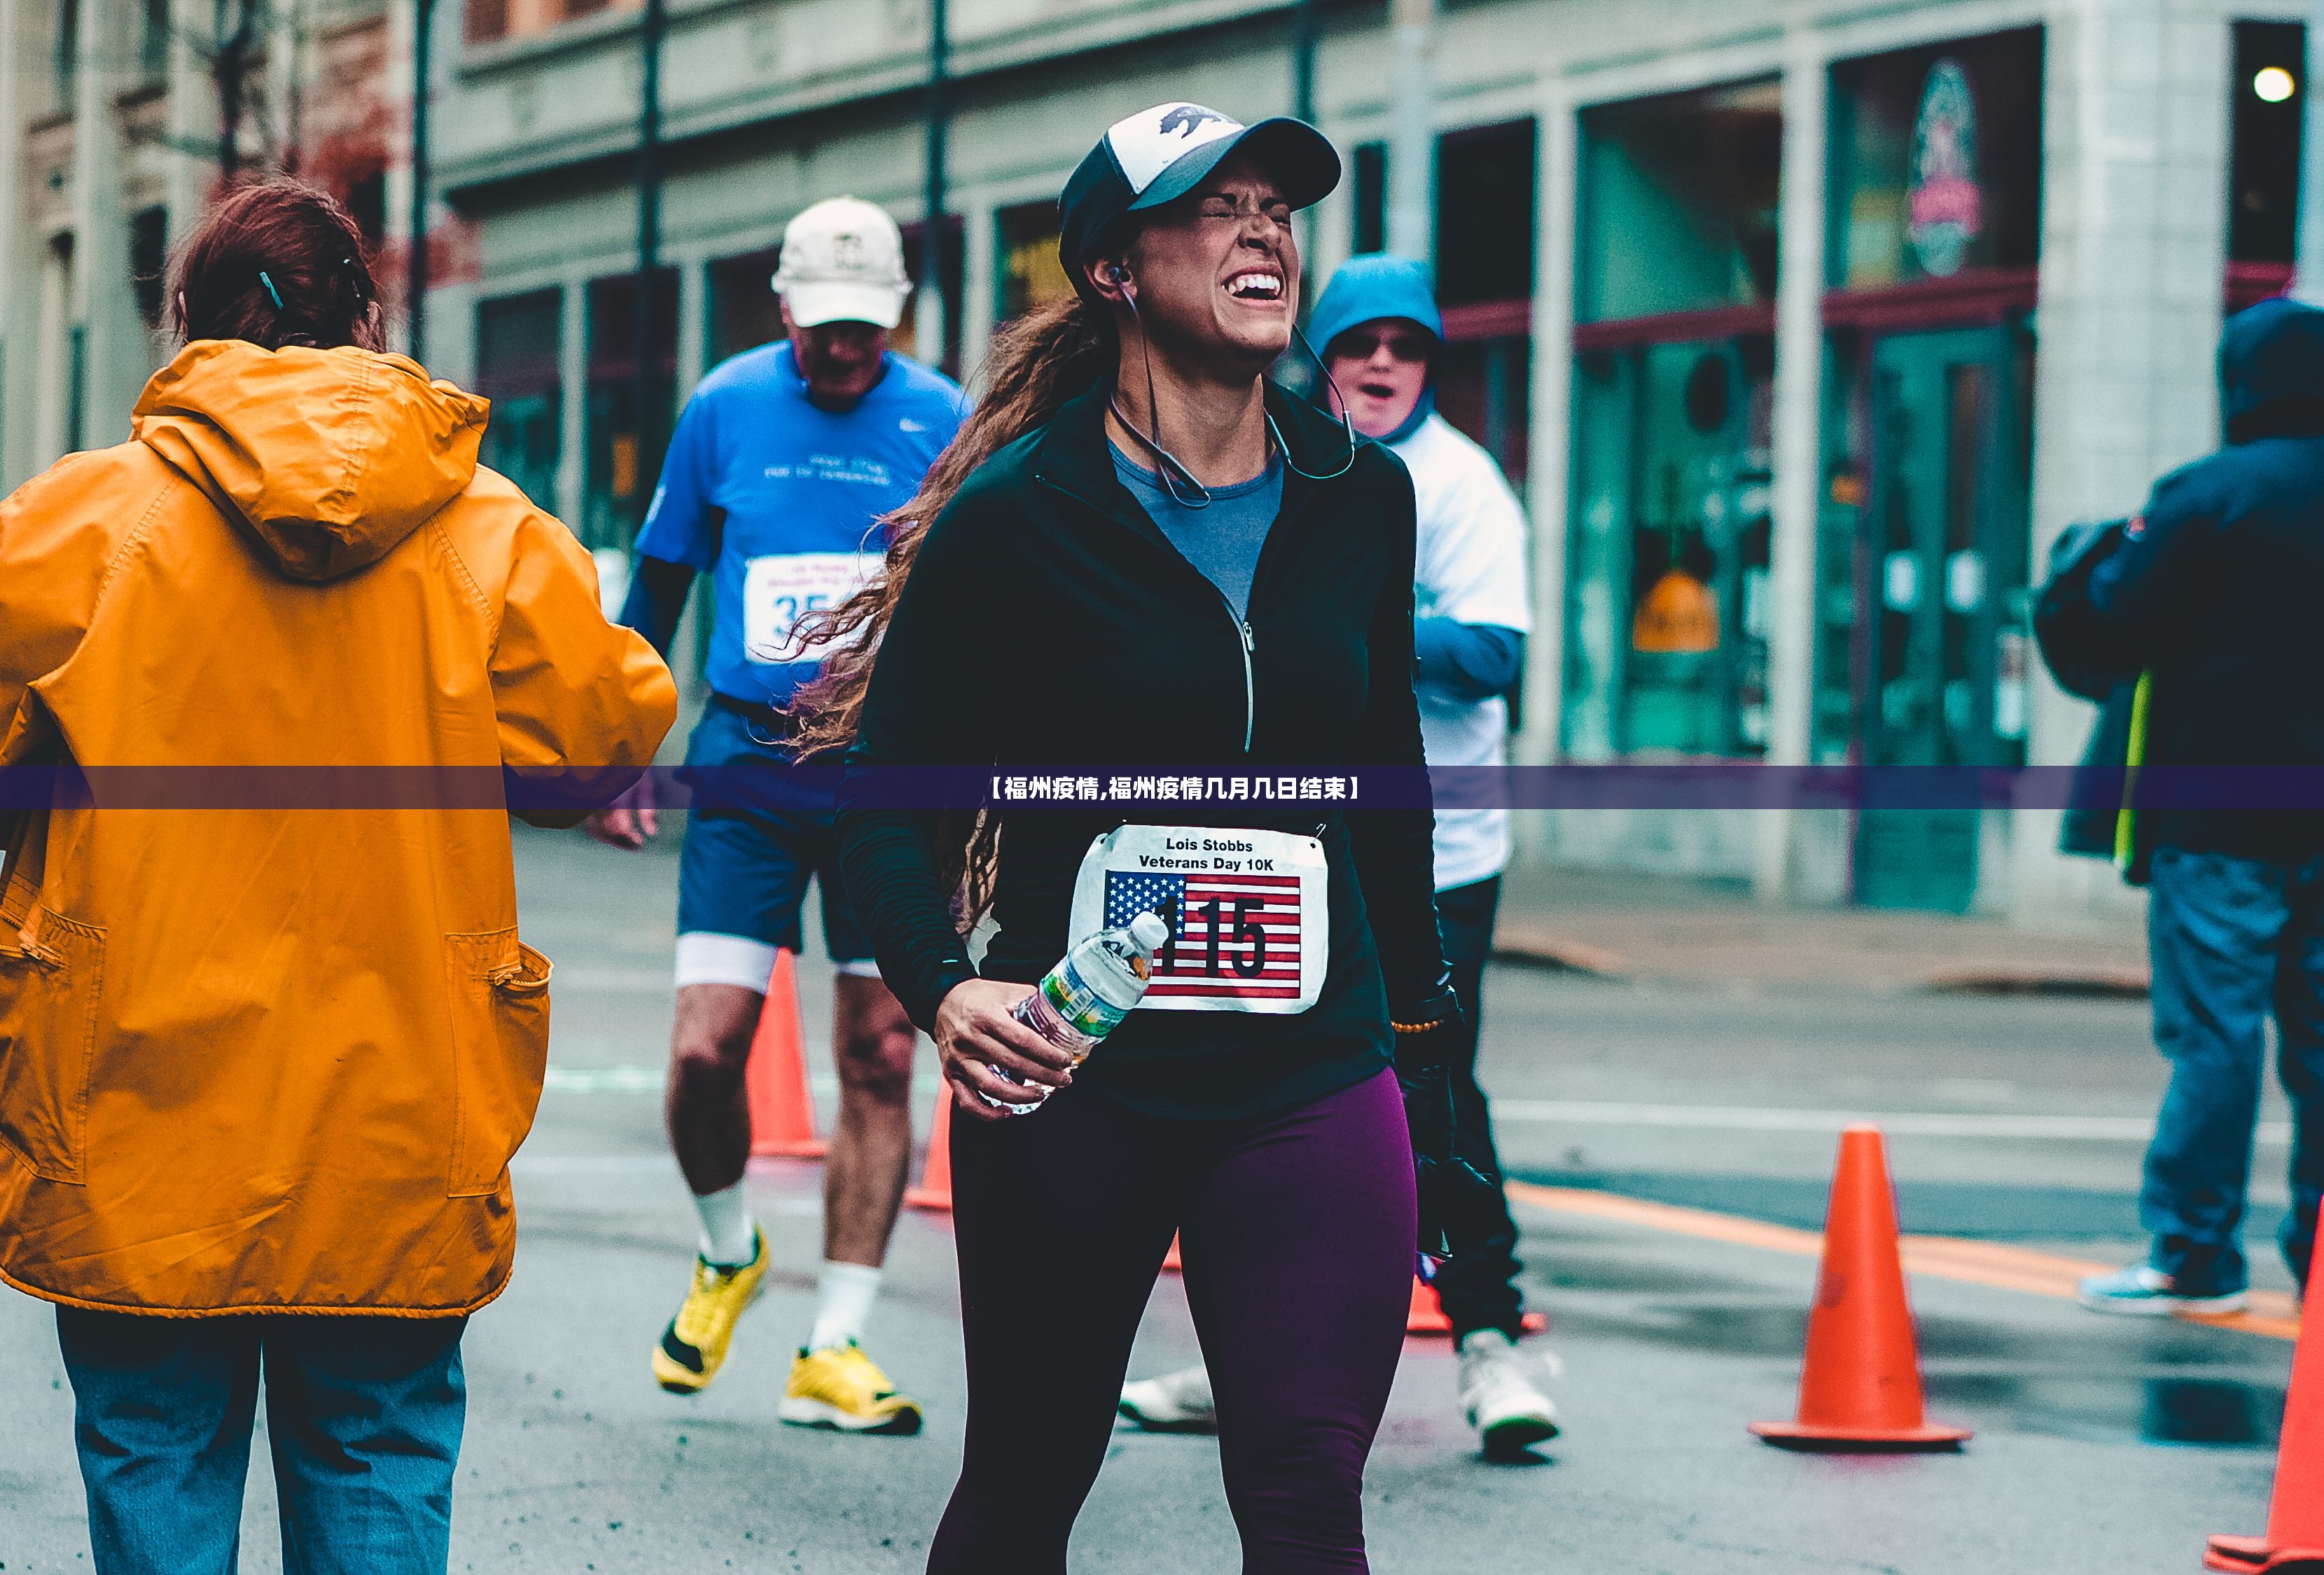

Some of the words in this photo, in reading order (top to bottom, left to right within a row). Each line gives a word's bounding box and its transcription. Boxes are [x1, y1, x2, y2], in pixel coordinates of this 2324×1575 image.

[1166, 837, 1198, 850] Lois
[1202, 839, 1253, 853] Stobbs
[1139, 855, 1209, 869] Veterans
[1213, 858, 1241, 872] Day
[1246, 858, 1274, 872] 10K
[1154, 895, 1266, 977] 115
